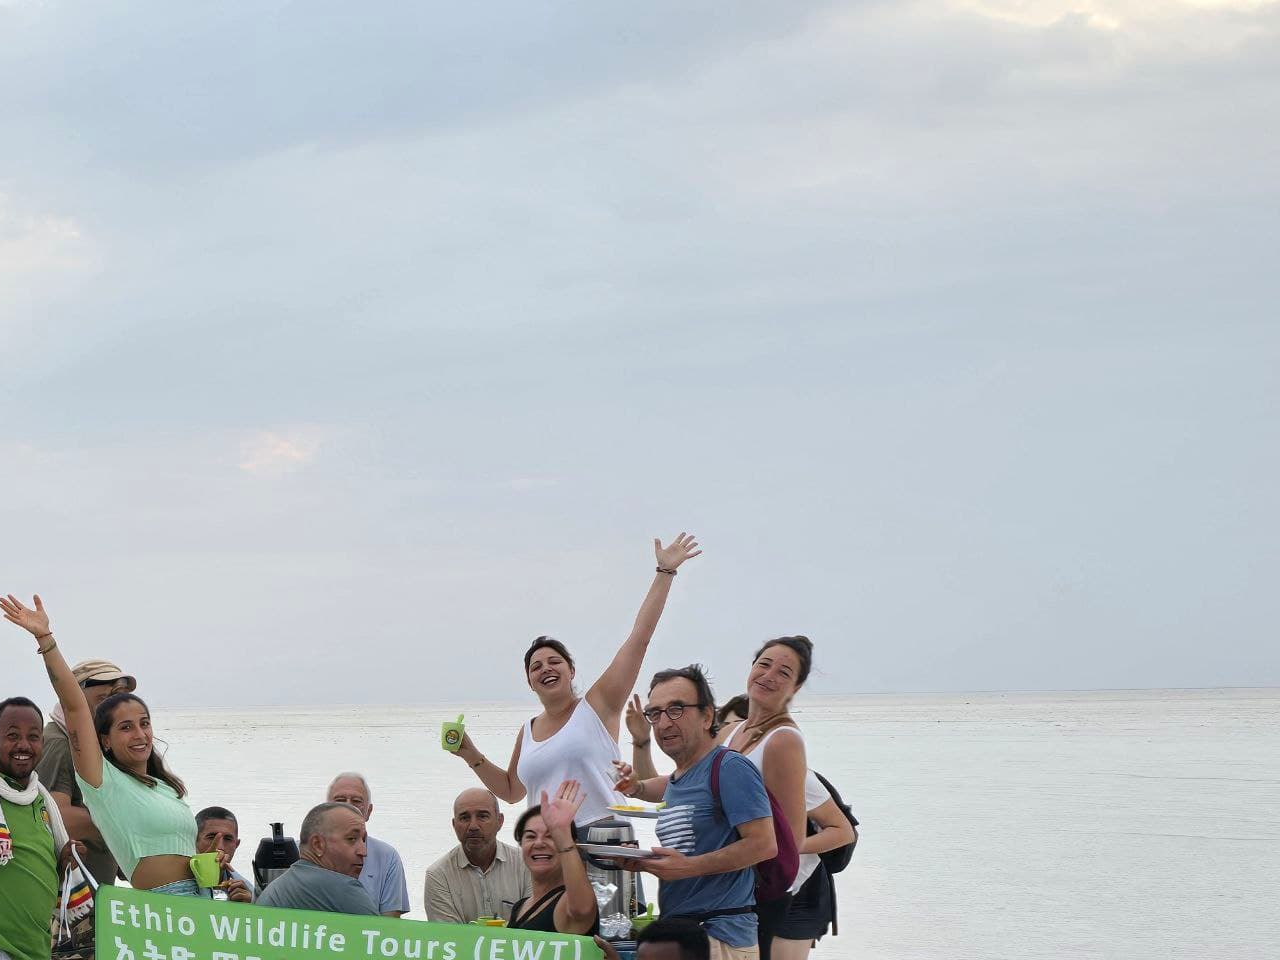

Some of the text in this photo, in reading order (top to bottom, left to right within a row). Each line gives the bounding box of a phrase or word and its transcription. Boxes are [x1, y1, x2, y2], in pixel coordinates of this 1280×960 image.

[110, 899, 196, 936] Ethio
[209, 914, 346, 952] Wildlife
[361, 929, 457, 960] Tours
